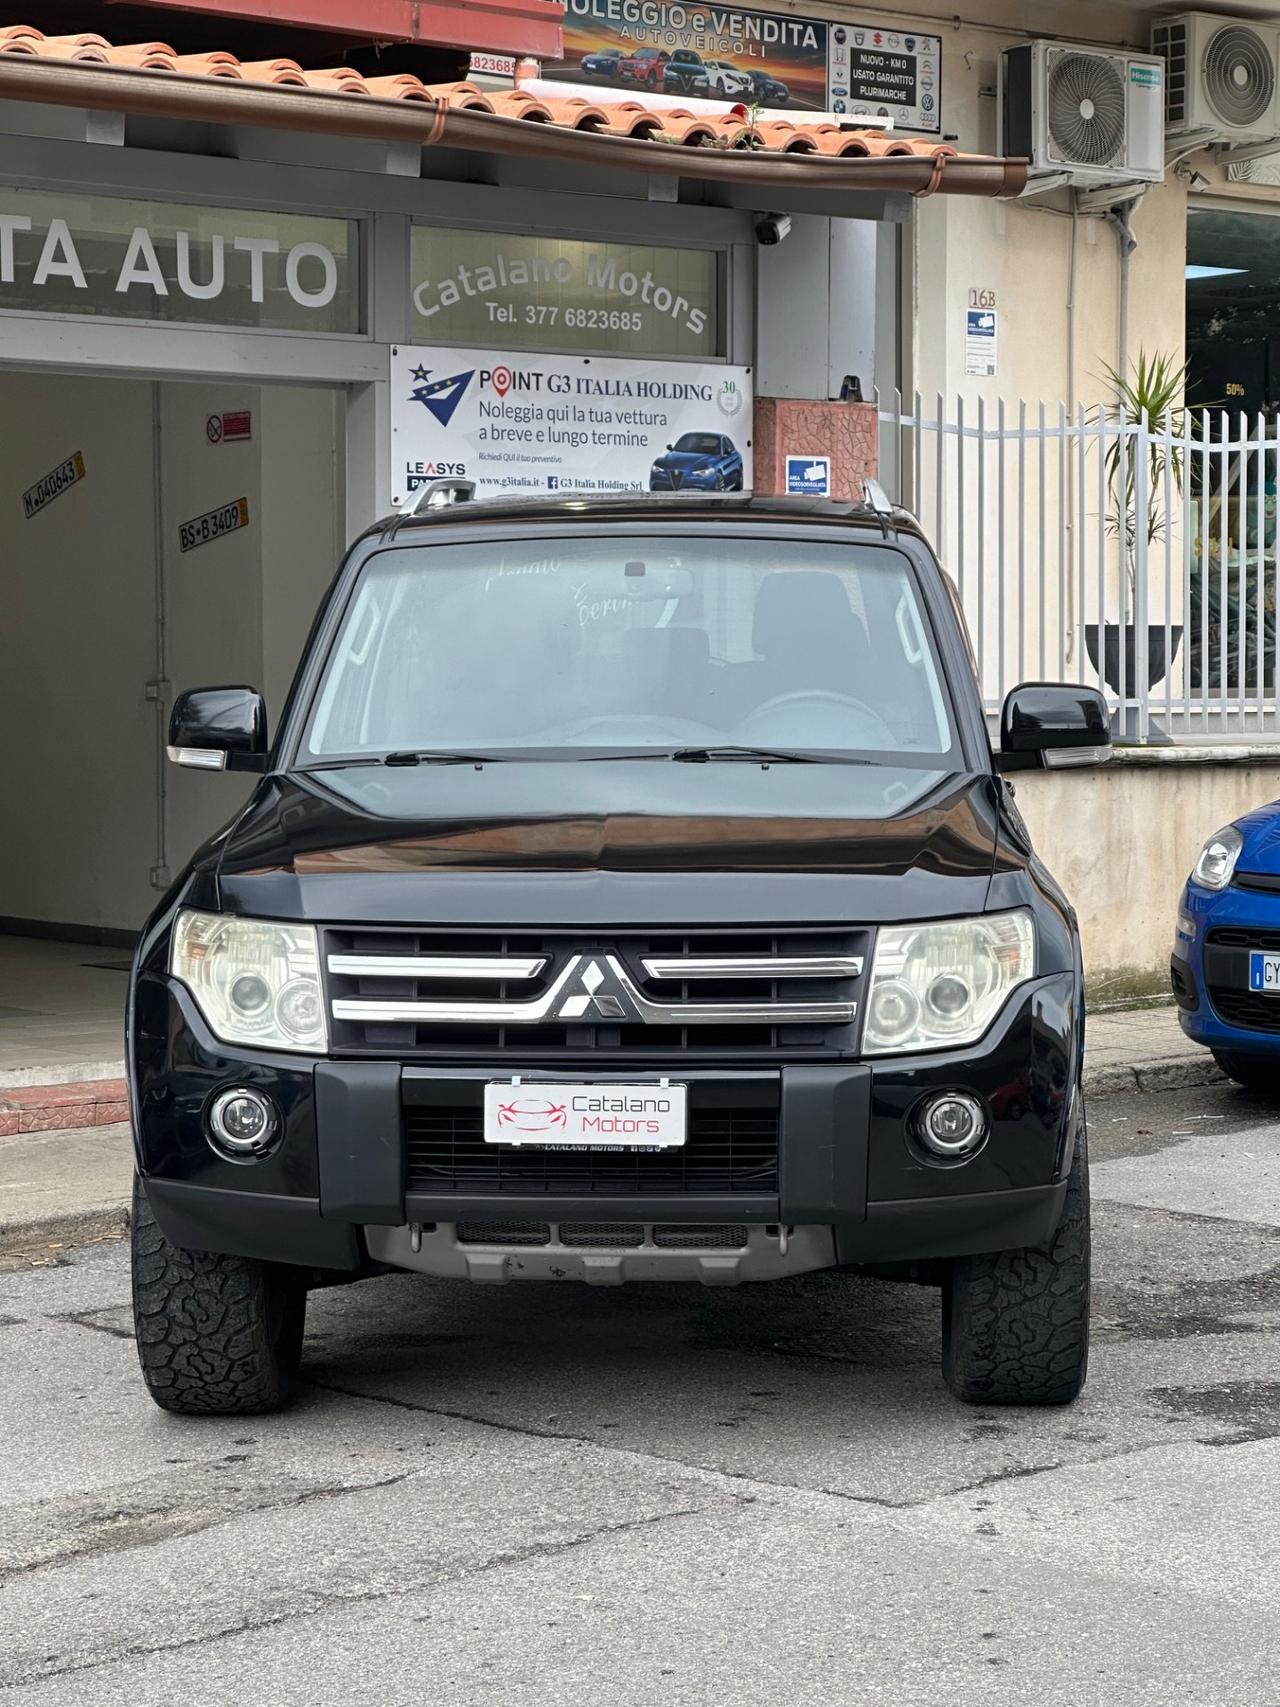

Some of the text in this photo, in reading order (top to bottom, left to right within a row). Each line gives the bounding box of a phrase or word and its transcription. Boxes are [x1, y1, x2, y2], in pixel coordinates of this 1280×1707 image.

[692, 12, 705, 32] e
[711, 12, 819, 49] VENDITA
[619, 26, 766, 58] AUTOVEICOLI
[860, 54, 884, 67] NUOVO
[890, 58, 900, 69] KM
[853, 68, 875, 81] USATO
[876, 71, 914, 86] GARANTITO
[860, 85, 907, 101] PLURIMARCHE
[0, 214, 338, 308] TA AUTO
[413, 253, 708, 334] Catalano Motors
[972, 289, 996, 307] 16B
[485, 302, 642, 331] Tel. 377 6823685
[480, 367, 545, 396] POINT
[547, 373, 571, 394] G3
[576, 378, 632, 397] ITALIA
[636, 381, 713, 402] HOLDING
[722, 380, 736, 394] 30
[1226, 383, 1245, 396] 50%
[480, 401, 668, 426] Noleggia qui la tua vettura
[479, 423, 649, 447] a breve e lungo termine
[478, 452, 500, 462] Richiedi
[503, 453, 516, 462] QUI
[521, 454, 531, 462] tuo
[531, 454, 563, 465] preventivo
[406, 461, 466, 476] LEASYS
[479, 476, 539, 488] www.g3italia.it
[560, 478, 572, 489] G3
[575, 479, 595, 490] Italia
[598, 480, 629, 491] Holding
[630, 481, 643, 491] Srl
[571, 1095, 671, 1113] Catalano
[582, 1115, 660, 1134] Motors
[544, 1144, 625, 1152] CATALANO MOTORS
